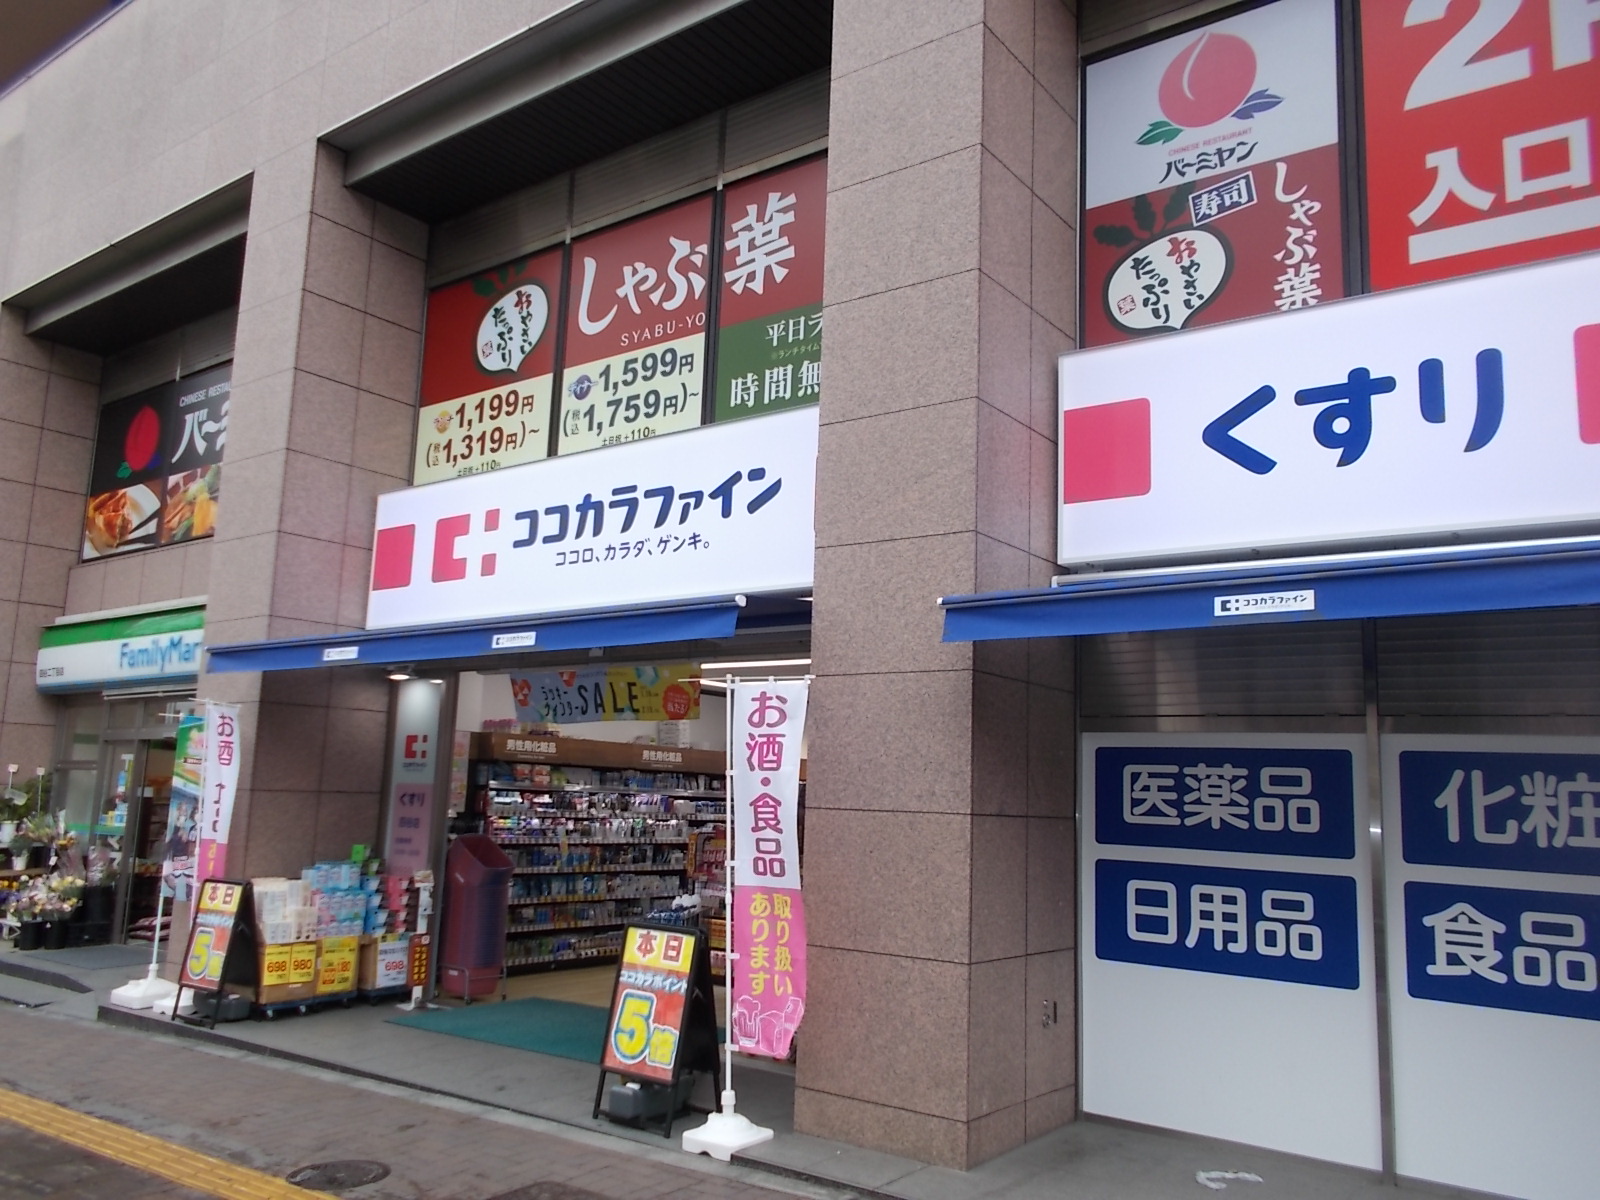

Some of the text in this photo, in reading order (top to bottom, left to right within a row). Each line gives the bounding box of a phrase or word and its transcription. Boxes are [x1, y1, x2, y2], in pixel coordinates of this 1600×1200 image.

[1158, 140, 1259, 184] バーミヤン
[1168, 127, 1253, 157] CHINESE RESTAURANT
[1408, 117, 1592, 228] 入口
[1195, 178, 1249, 220] 寿司
[1273, 161, 1323, 311] しゃぶ葉
[577, 191, 798, 336] しゃぶ葉
[1166, 236, 1205, 310] おやさい
[1129, 255, 1171, 325] たっぷり
[620, 311, 706, 347] SYABU-YO
[598, 347, 695, 397] 1,599円
[729, 359, 822, 408] 時間無
[454, 389, 535, 432] 1,199円
[1201, 347, 1505, 476] くすり
[512, 466, 783, 549] ココカラファイン
[554, 532, 710, 567] ココロ、カラダ、ゲンキ。
[1243, 594, 1308, 607] ココカラファイン
[576, 681, 641, 716] SALE
[745, 690, 788, 879] お酒・食品
[1122, 762, 1321, 834] 医薬品
[1433, 769, 1600, 849] 化粧
[207, 883, 236, 906] 本日
[749, 892, 772, 996] あります
[1125, 878, 1323, 962] 日用品
[266, 960, 287, 973] 698
[292, 958, 312, 971] 980
[384, 959, 404, 972] 698
[635, 930, 685, 963] 本日
[773, 893, 793, 998] 取り扱い
[1421, 901, 1598, 992] 食品
[620, 969, 689, 994] ココカラポイント
